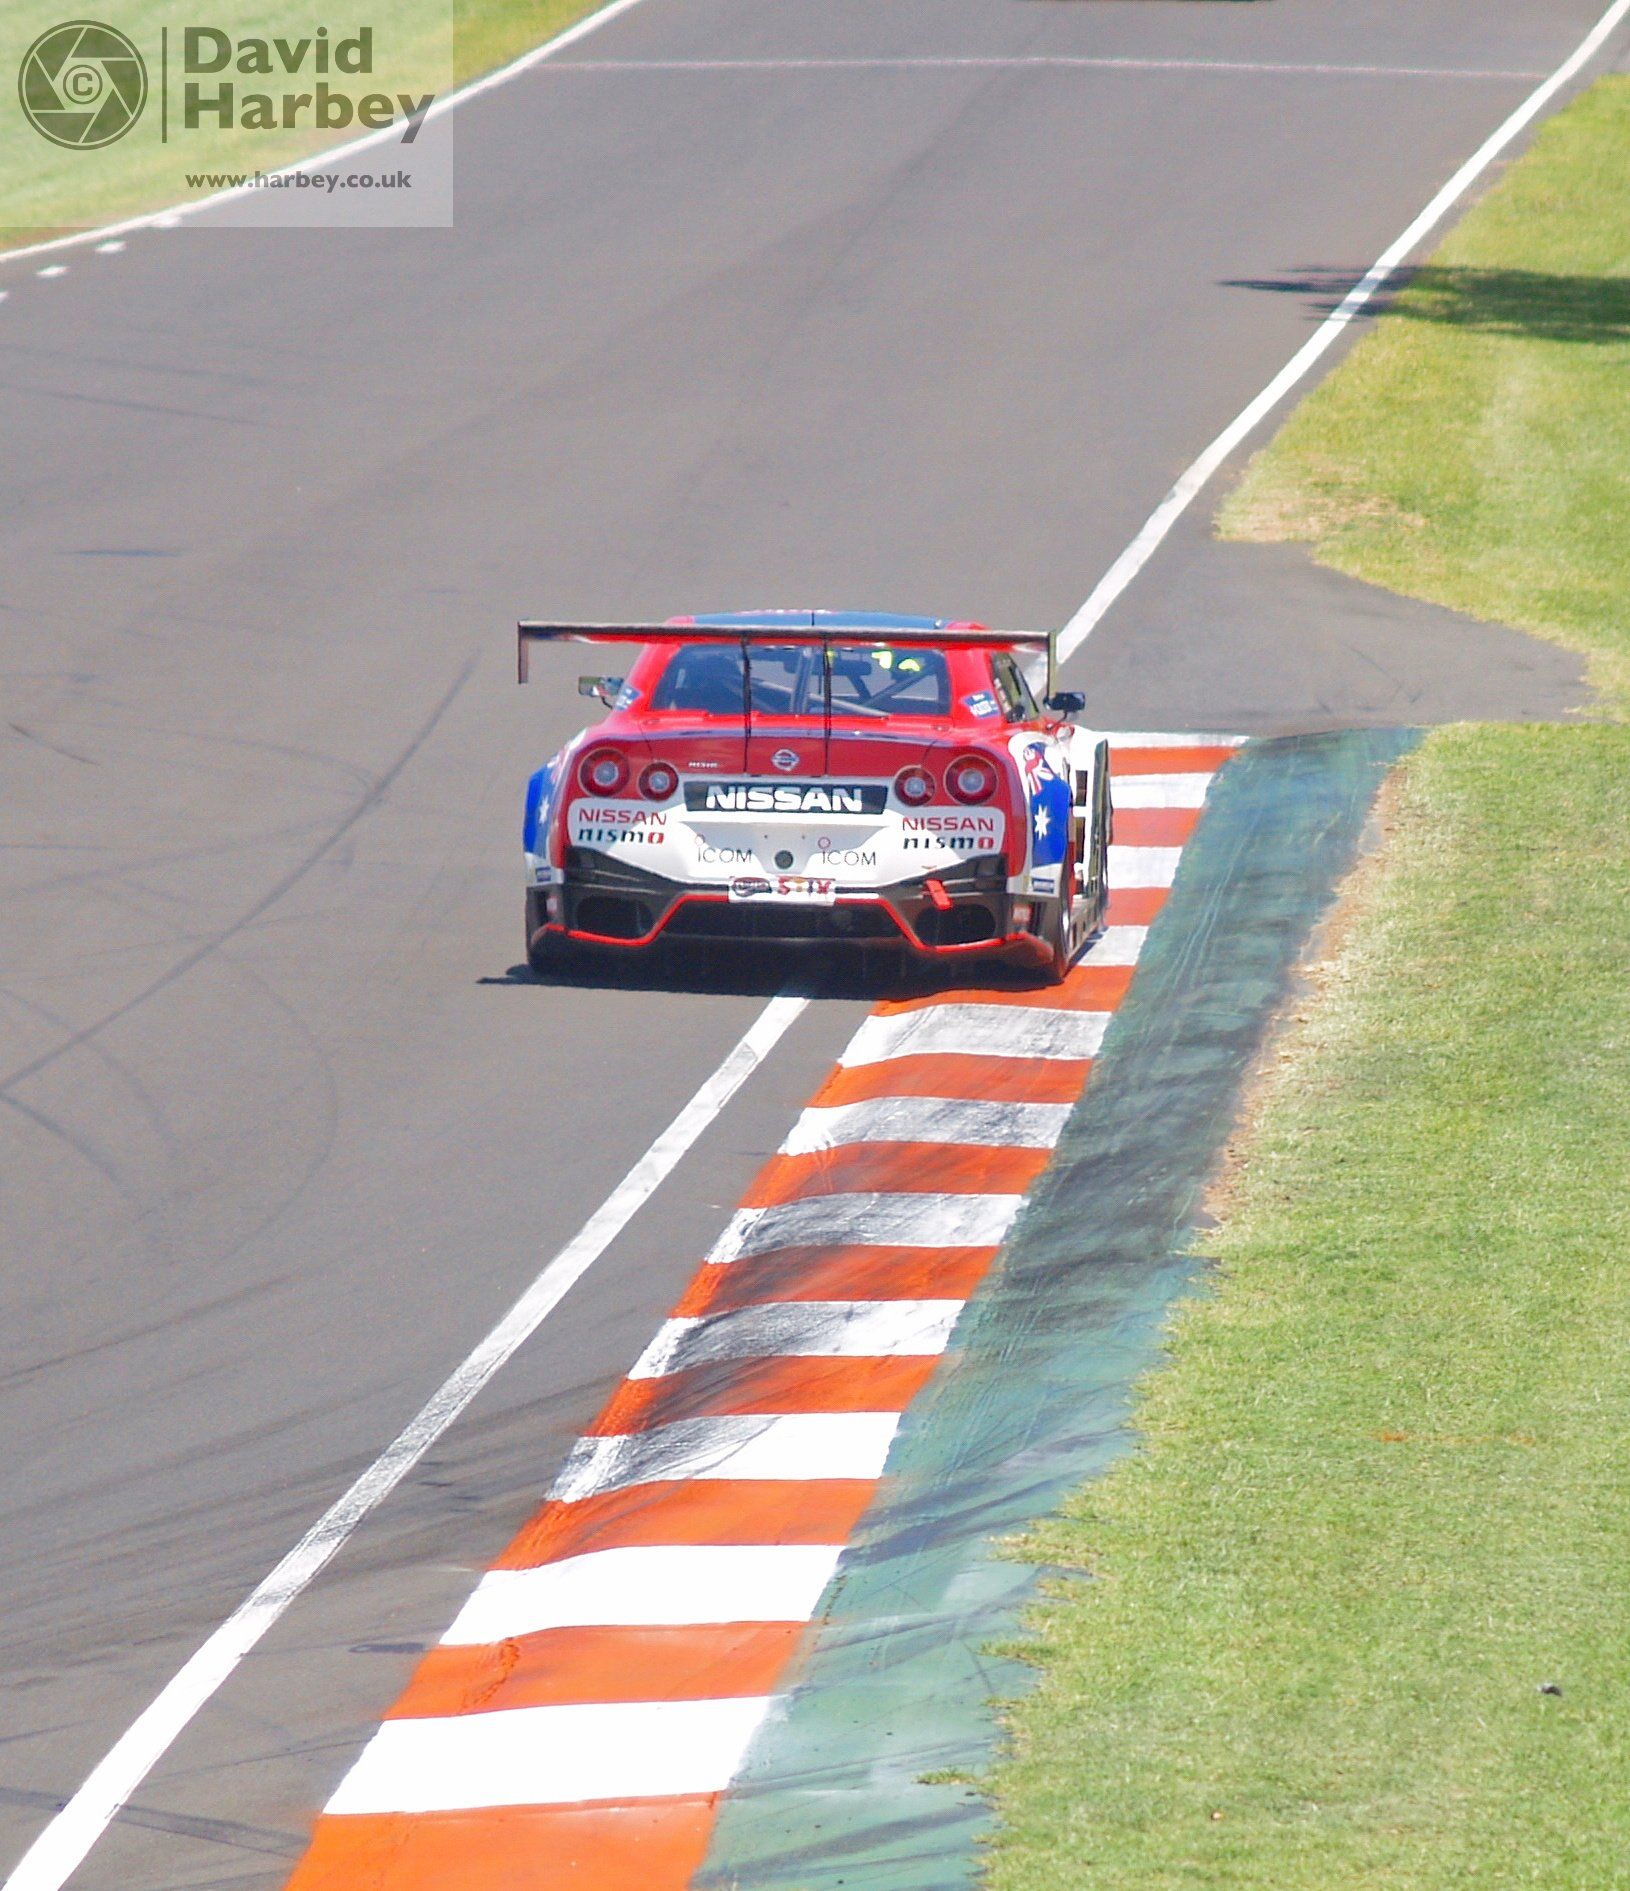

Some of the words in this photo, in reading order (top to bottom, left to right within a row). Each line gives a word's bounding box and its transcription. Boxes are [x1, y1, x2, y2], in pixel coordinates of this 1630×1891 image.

[706, 784, 863, 812] NISSAN
[579, 808, 667, 825] NISSAN
[902, 816, 994, 831] NISSAN
